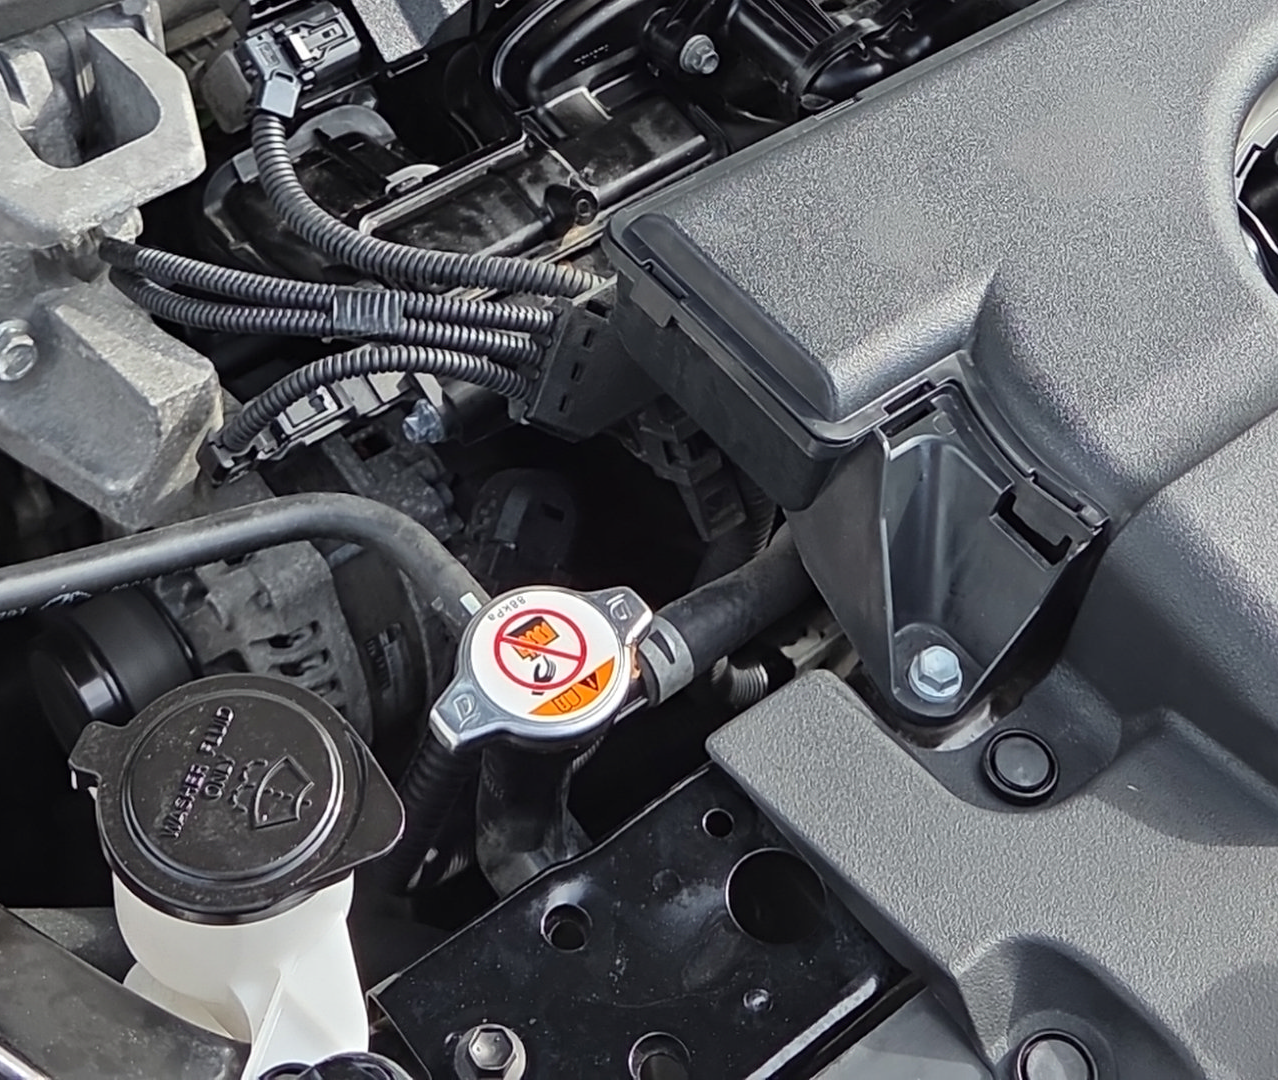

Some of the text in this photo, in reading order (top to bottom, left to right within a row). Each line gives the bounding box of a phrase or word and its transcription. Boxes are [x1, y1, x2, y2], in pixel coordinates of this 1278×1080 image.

[487, 595, 527, 621] 88kPa
[161, 704, 237, 841] WASHER FLUID
[202, 753, 237, 801] ONLY
